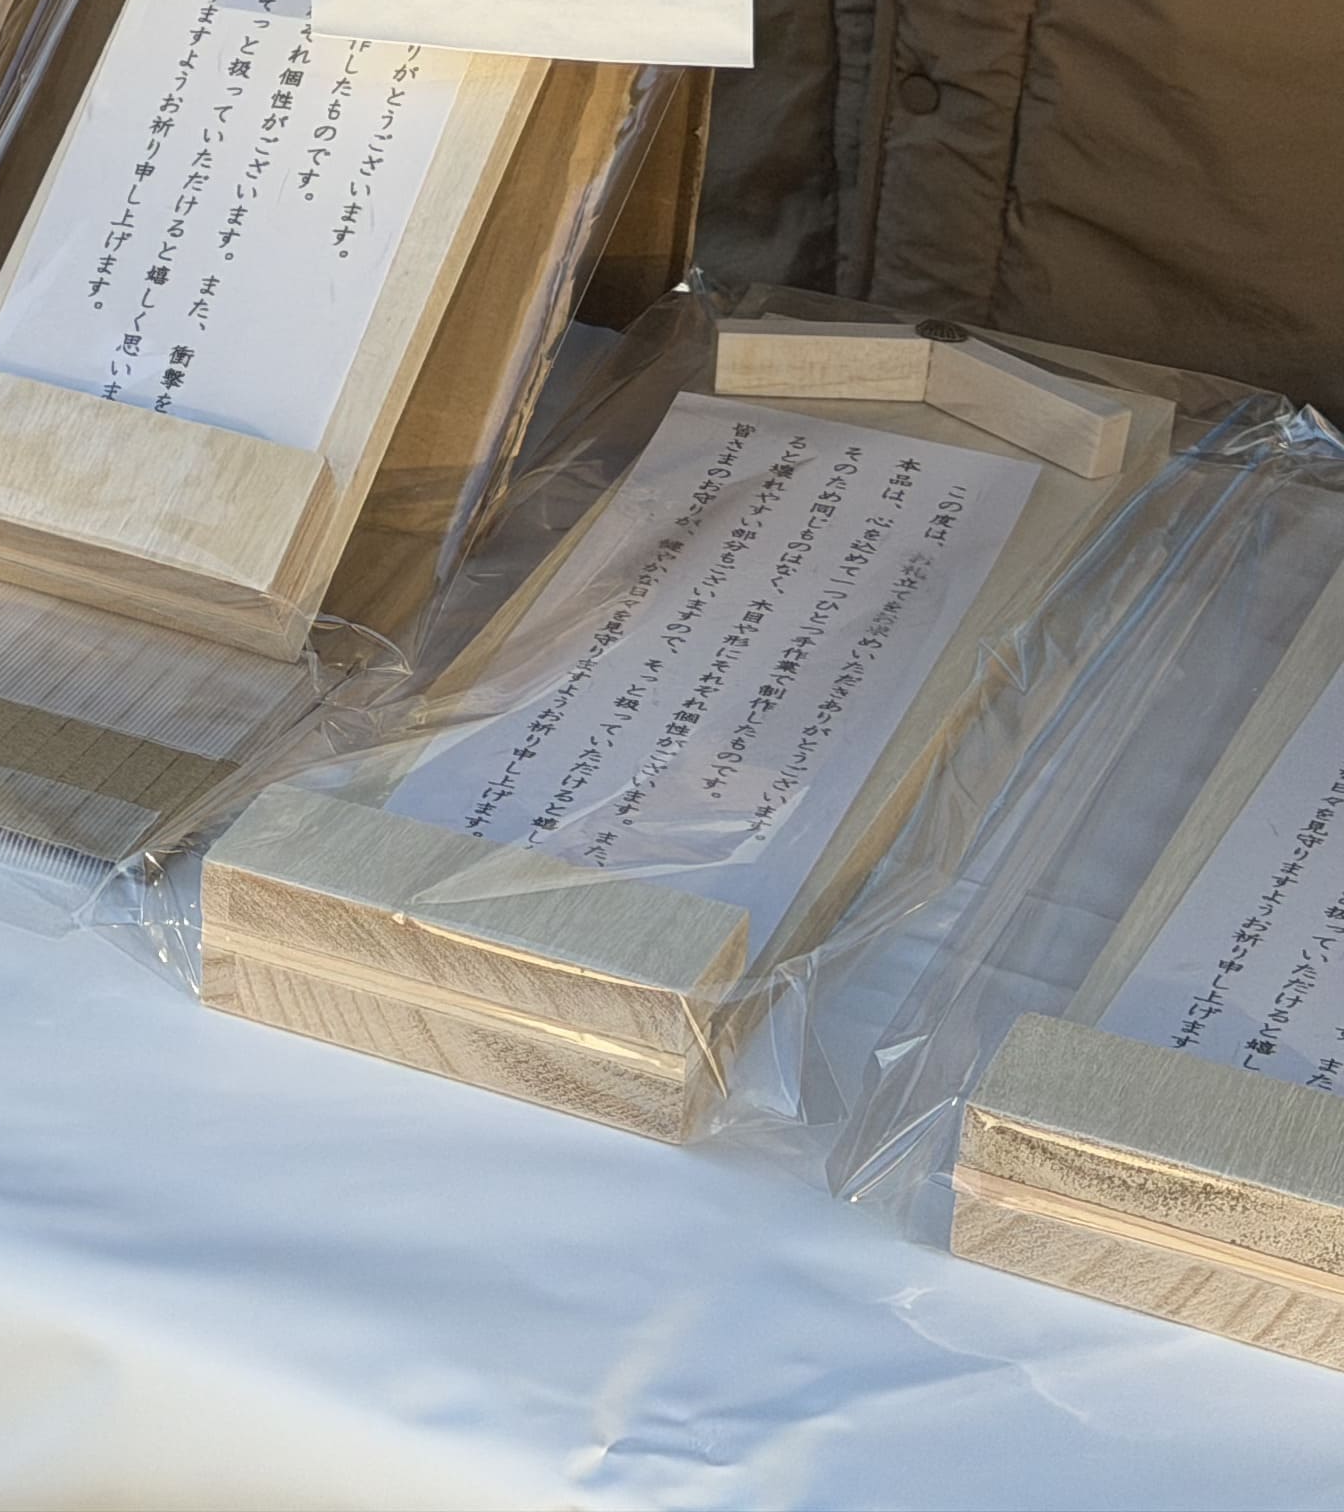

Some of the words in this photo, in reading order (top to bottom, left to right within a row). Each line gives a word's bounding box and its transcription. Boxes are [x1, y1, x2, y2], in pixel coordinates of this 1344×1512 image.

[524, 435, 806, 849] ると壊れやすい部分もございますので、そっと扱っていただけると嬉し
[1171, 766, 1344, 1048] 日々を見守りますようお祈り申し上げます
